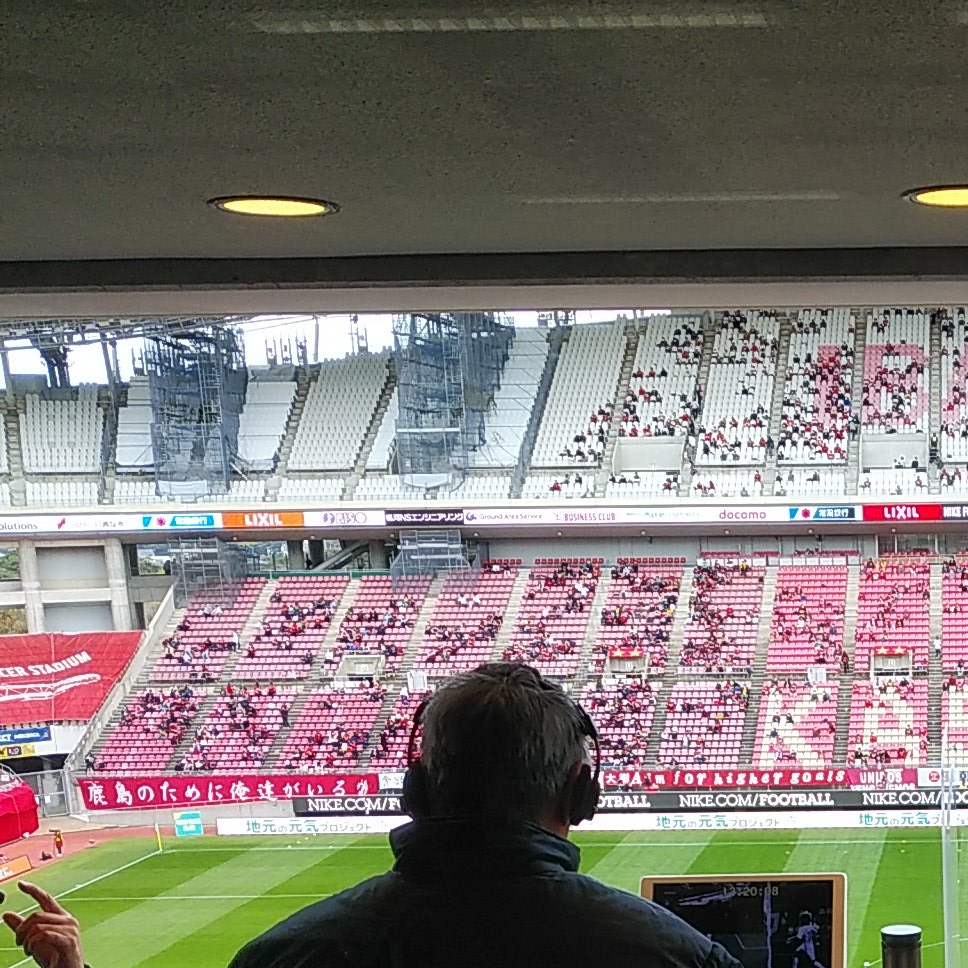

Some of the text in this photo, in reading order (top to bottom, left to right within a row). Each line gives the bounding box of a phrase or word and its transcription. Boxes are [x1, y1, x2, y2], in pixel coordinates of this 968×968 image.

[598, 512, 616, 521] CLUB
[719, 509, 767, 520] docomo
[883, 505, 919, 520] LIXIL
[943, 506, 961, 518] NIKE
[244, 513, 283, 527] LIXIL
[28, 651, 92, 676] STADIUM
[673, 770, 707, 786] for
[713, 771, 783, 786] higher
[790, 769, 846, 785] goals
[679, 793, 834, 808] NIKE.COM/FOOTBALL
[246, 819, 371, 833] 地元の元気プロジェクト
[656, 815, 781, 829] 地元の元気プロジェクト
